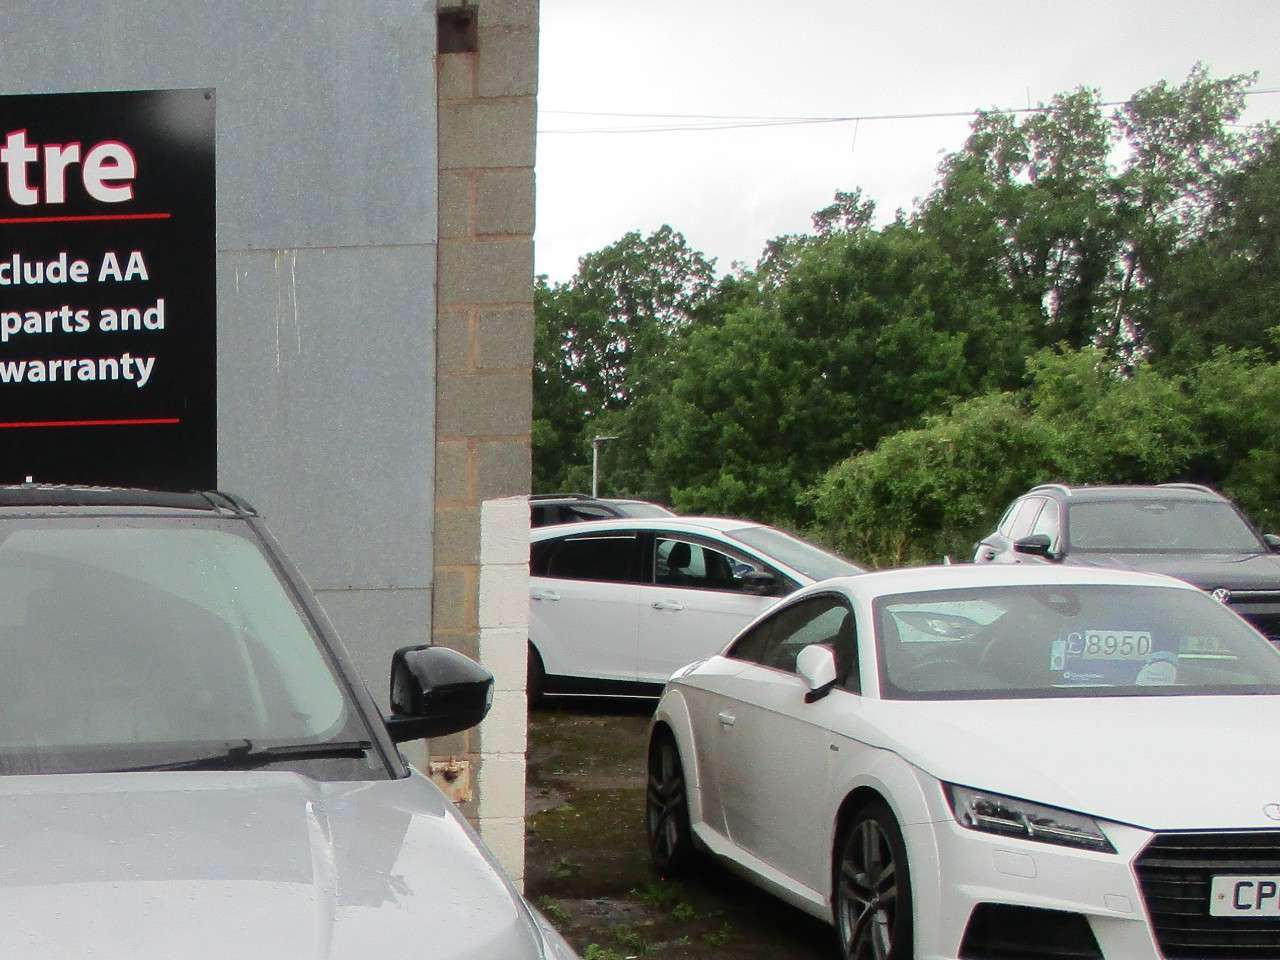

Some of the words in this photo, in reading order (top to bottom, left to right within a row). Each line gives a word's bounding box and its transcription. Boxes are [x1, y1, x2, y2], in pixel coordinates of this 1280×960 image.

[97, 251, 149, 282] AA
[0, 305, 90, 342] parts
[99, 298, 165, 332] and
[1232, 880, 1280, 910] CP
